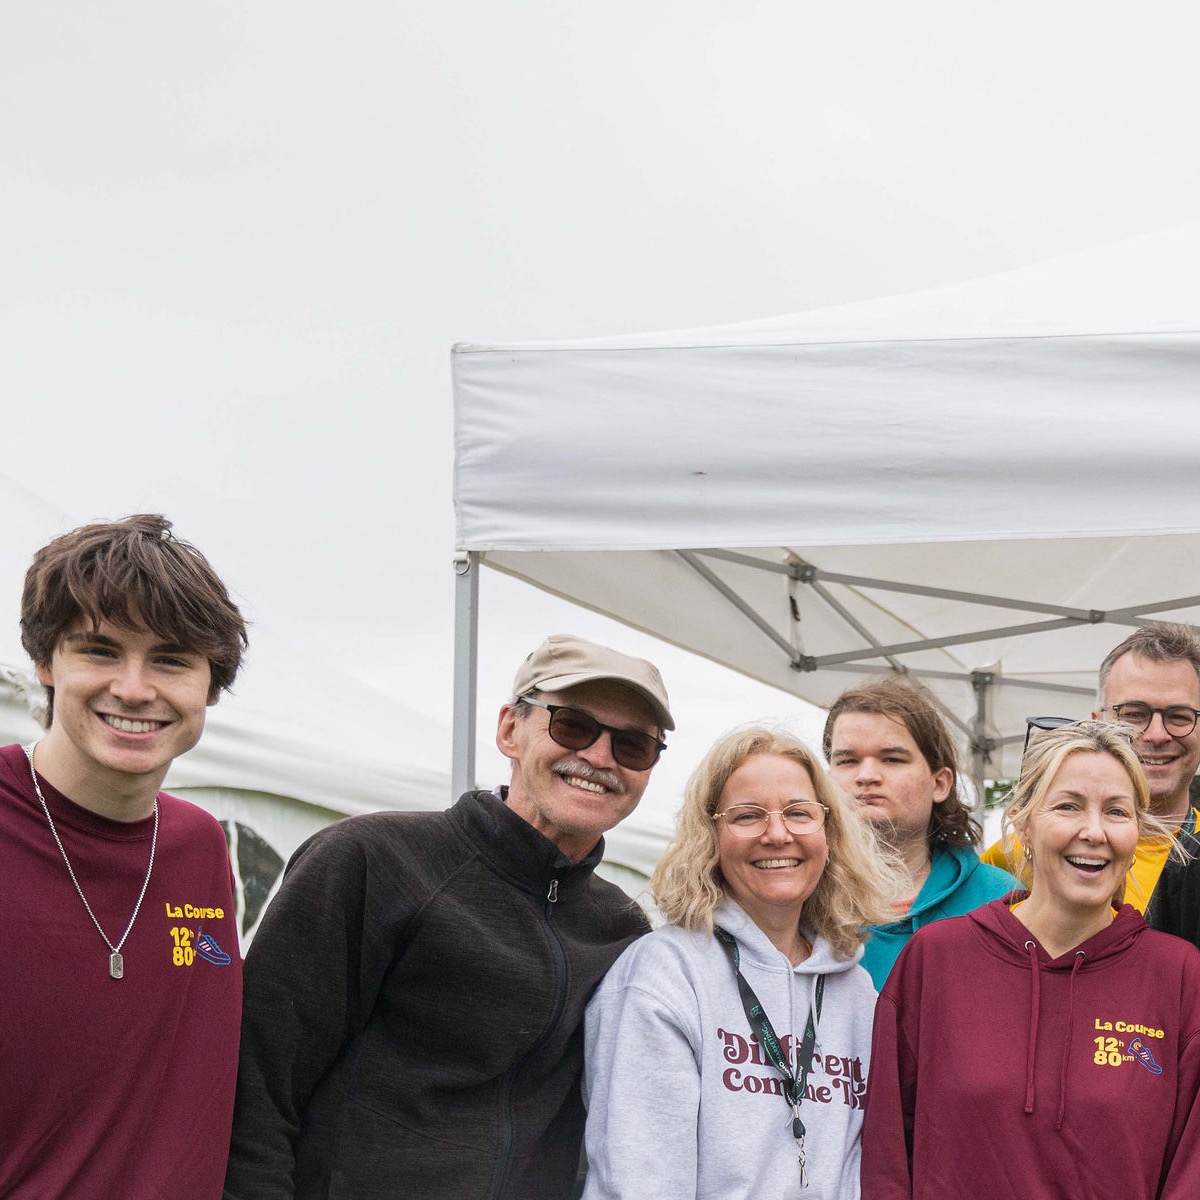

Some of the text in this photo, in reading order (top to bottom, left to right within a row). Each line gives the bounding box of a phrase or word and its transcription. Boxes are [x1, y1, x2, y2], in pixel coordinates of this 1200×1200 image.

[165, 902, 183, 918] La
[1094, 1018, 1165, 1039] La Course
